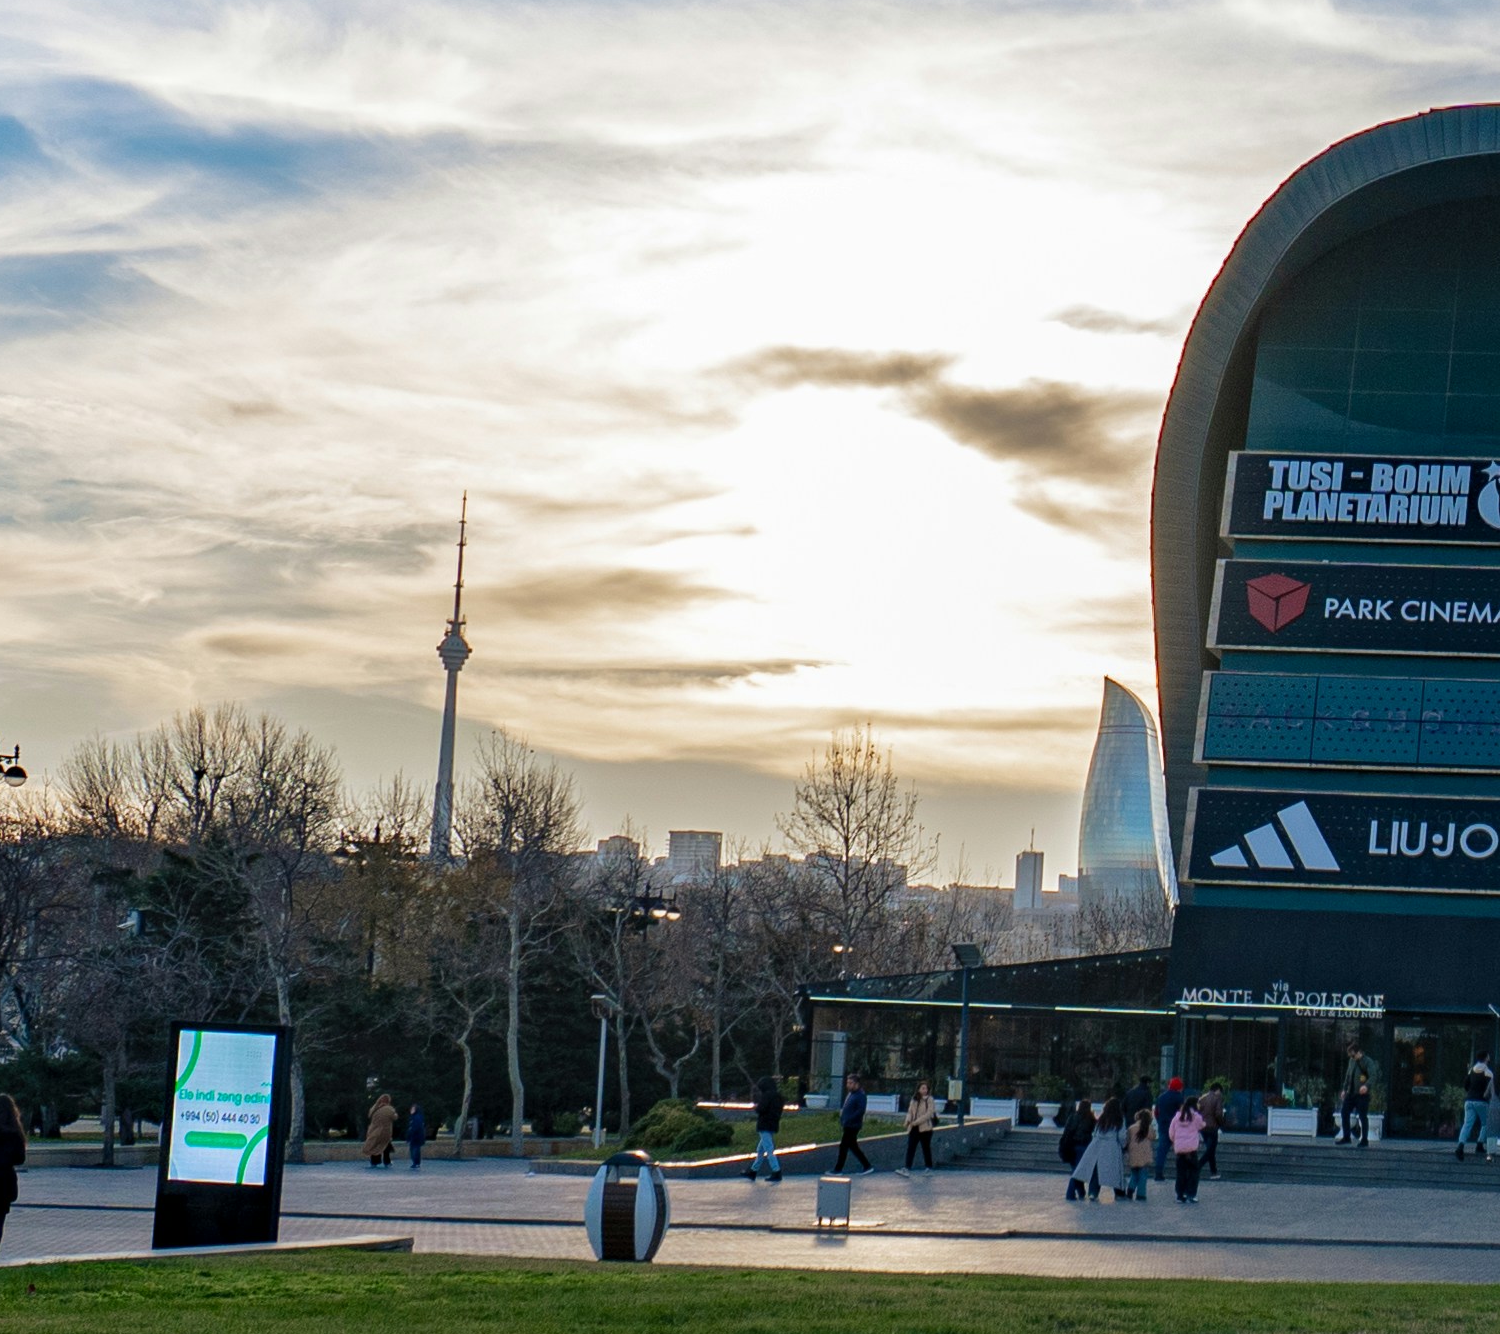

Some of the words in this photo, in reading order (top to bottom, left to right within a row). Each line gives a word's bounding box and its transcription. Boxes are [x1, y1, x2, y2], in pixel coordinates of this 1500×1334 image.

[1268, 460, 1344, 491] TUSI
[1371, 463, 1471, 495] BOHM
[1263, 490, 1468, 527] PLANETARIUM
[1324, 597, 1394, 621] PARK
[1272, 979, 1289, 992] via
[1181, 987, 1253, 1004] MONTE
[1264, 991, 1385, 1009] NAPOLEONE
[196, 1089, 215, 1101] indi
[180, 1111, 200, 1121] +994
[203, 1109, 219, 1124] (50)
[221, 1112, 237, 1123] 444
[238, 1113, 248, 1124] 40
[250, 1114, 261, 1124] 30
